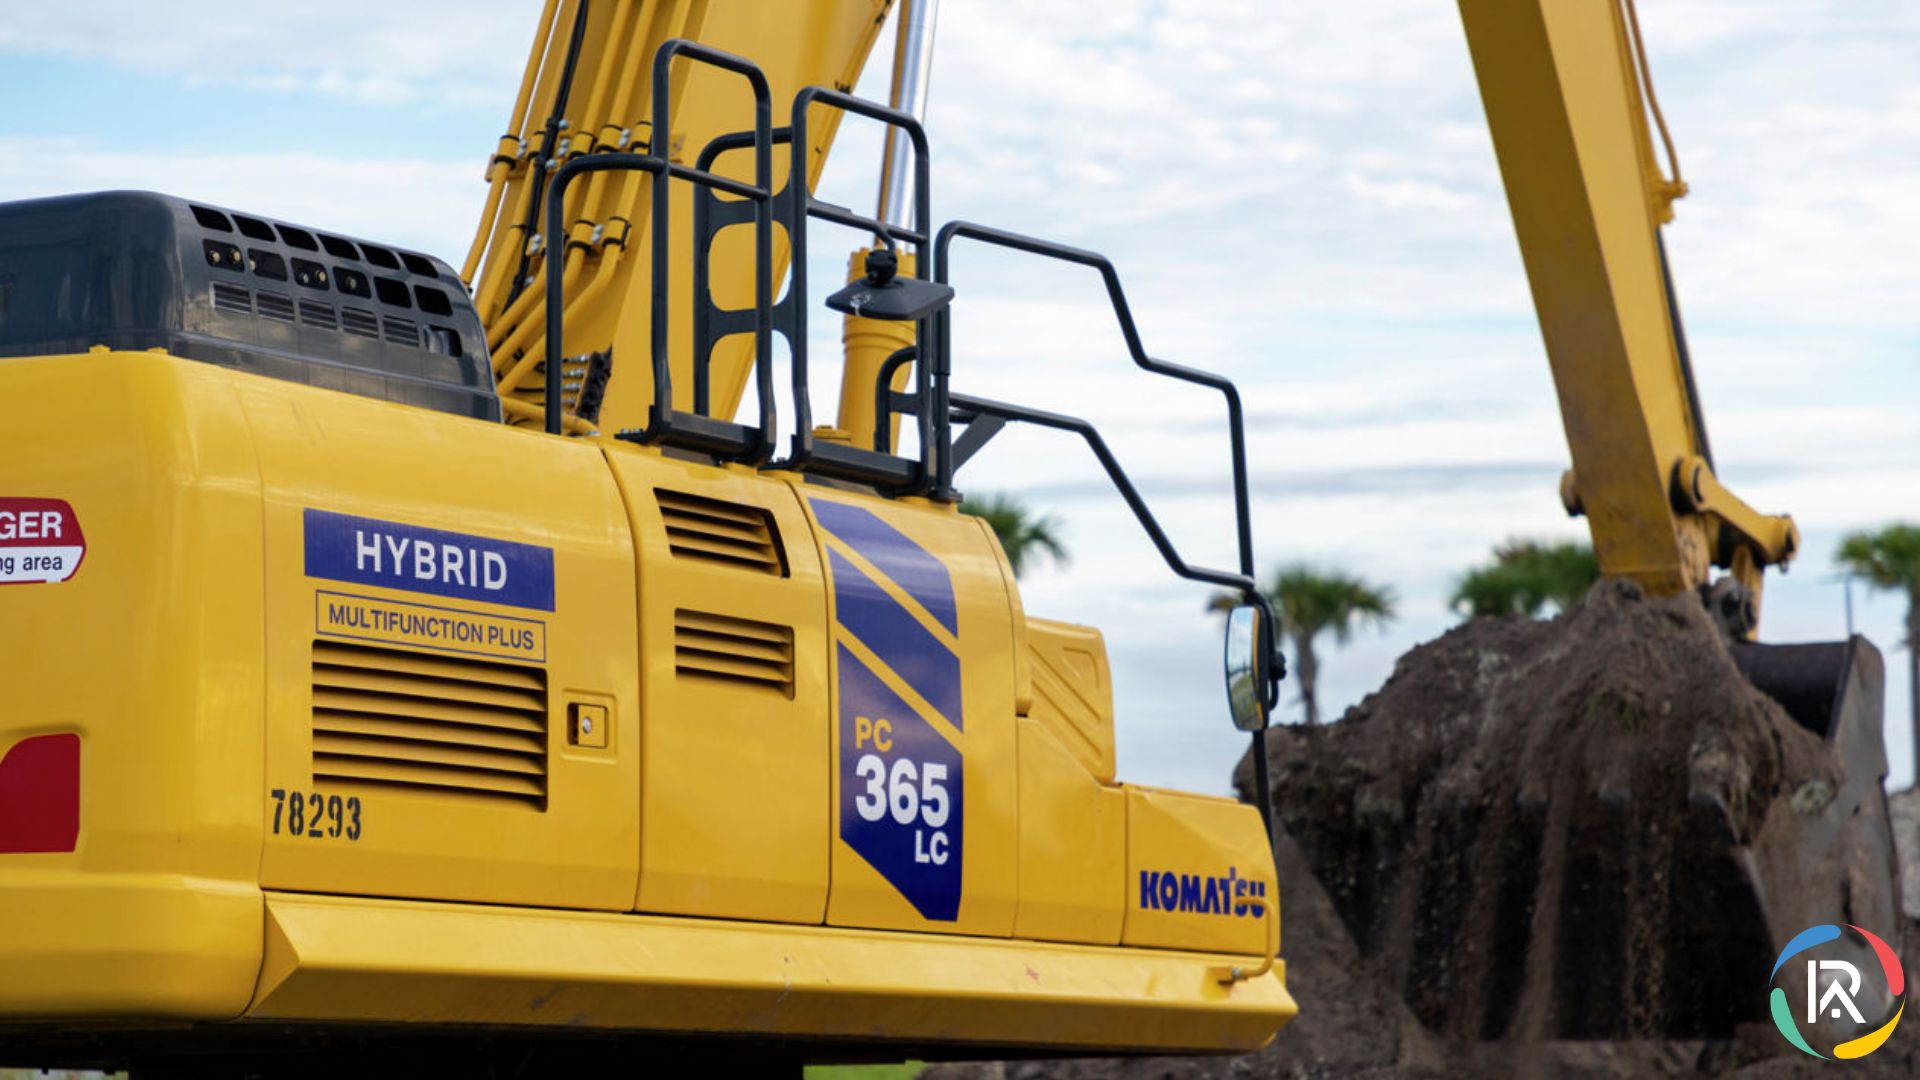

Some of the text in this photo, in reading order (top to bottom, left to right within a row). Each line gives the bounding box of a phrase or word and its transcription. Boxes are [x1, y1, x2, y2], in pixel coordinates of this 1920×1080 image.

[23, 555, 63, 571] area
[356, 530, 508, 590] HYBRID
[328, 603, 534, 650] MULTIFUNCTION PLUS
[855, 716, 893, 752] PC
[271, 789, 361, 840] 78293
[855, 754, 950, 828] 365
[915, 830, 949, 865] LC
[1140, 866, 1265, 918] KOMATSU
